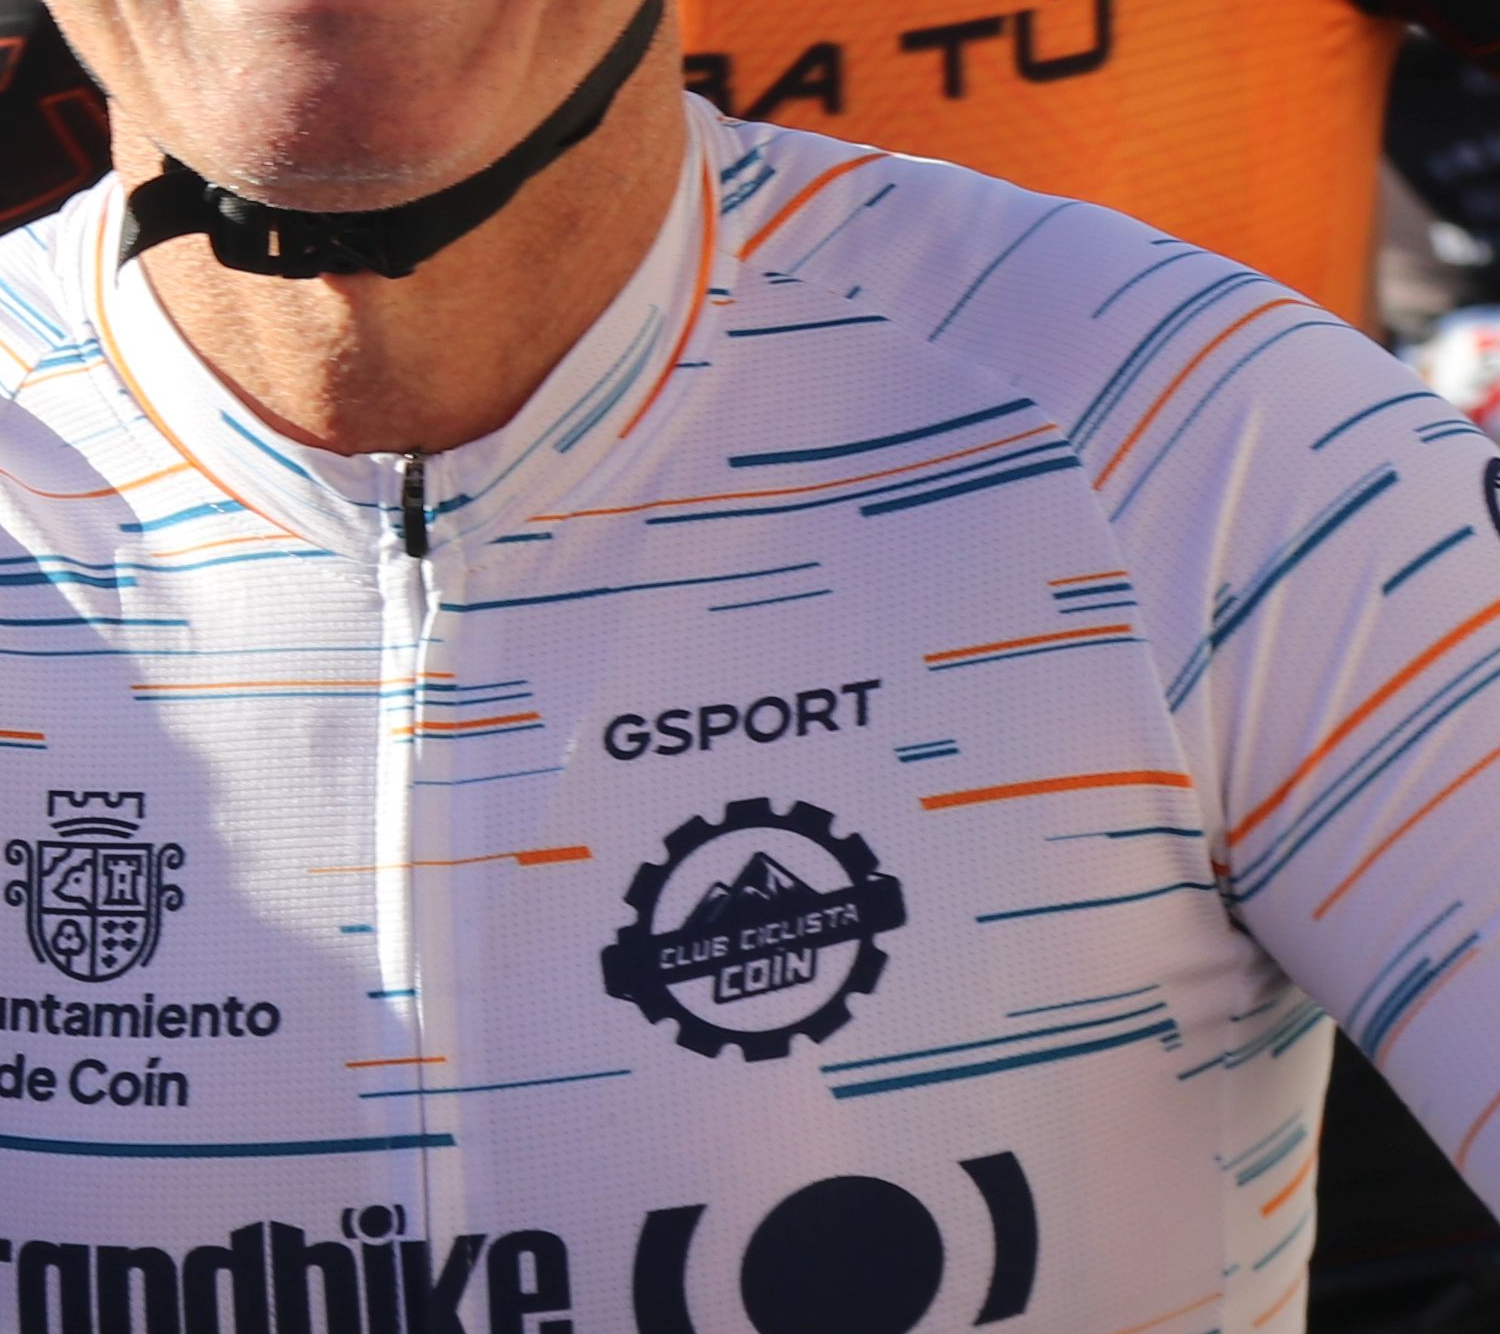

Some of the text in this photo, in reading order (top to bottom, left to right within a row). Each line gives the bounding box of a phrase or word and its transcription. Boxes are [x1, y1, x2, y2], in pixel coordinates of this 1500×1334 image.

[603, 679, 882, 761] GSPORT
[659, 902, 861, 970] CLUB CICLISTA
[69, 1055, 190, 1107] Coín
